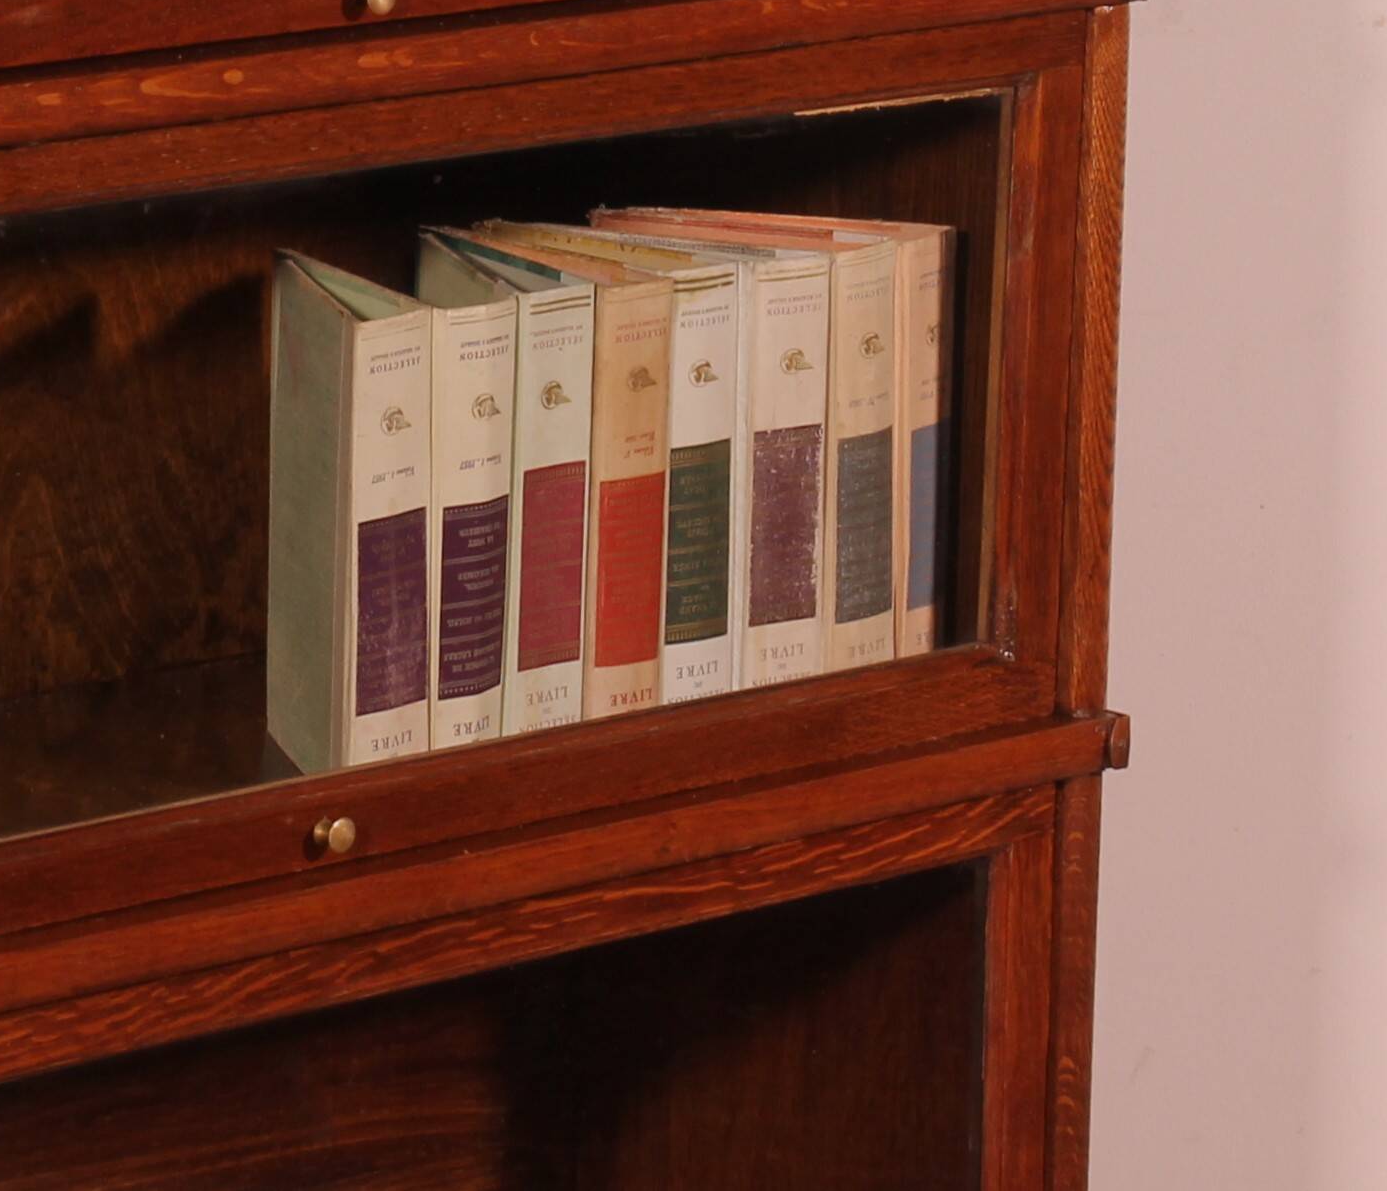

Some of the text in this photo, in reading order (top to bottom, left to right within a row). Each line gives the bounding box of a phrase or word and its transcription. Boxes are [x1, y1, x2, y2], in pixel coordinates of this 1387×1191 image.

[759, 642, 805, 662] LIVRE
[675, 659, 719, 680] LIVRE
[525, 685, 569, 707] LIVRE
[609, 687, 653, 708] LIVRE
[452, 715, 490, 737] LIVRE
[370, 729, 413, 753] LIVRE
